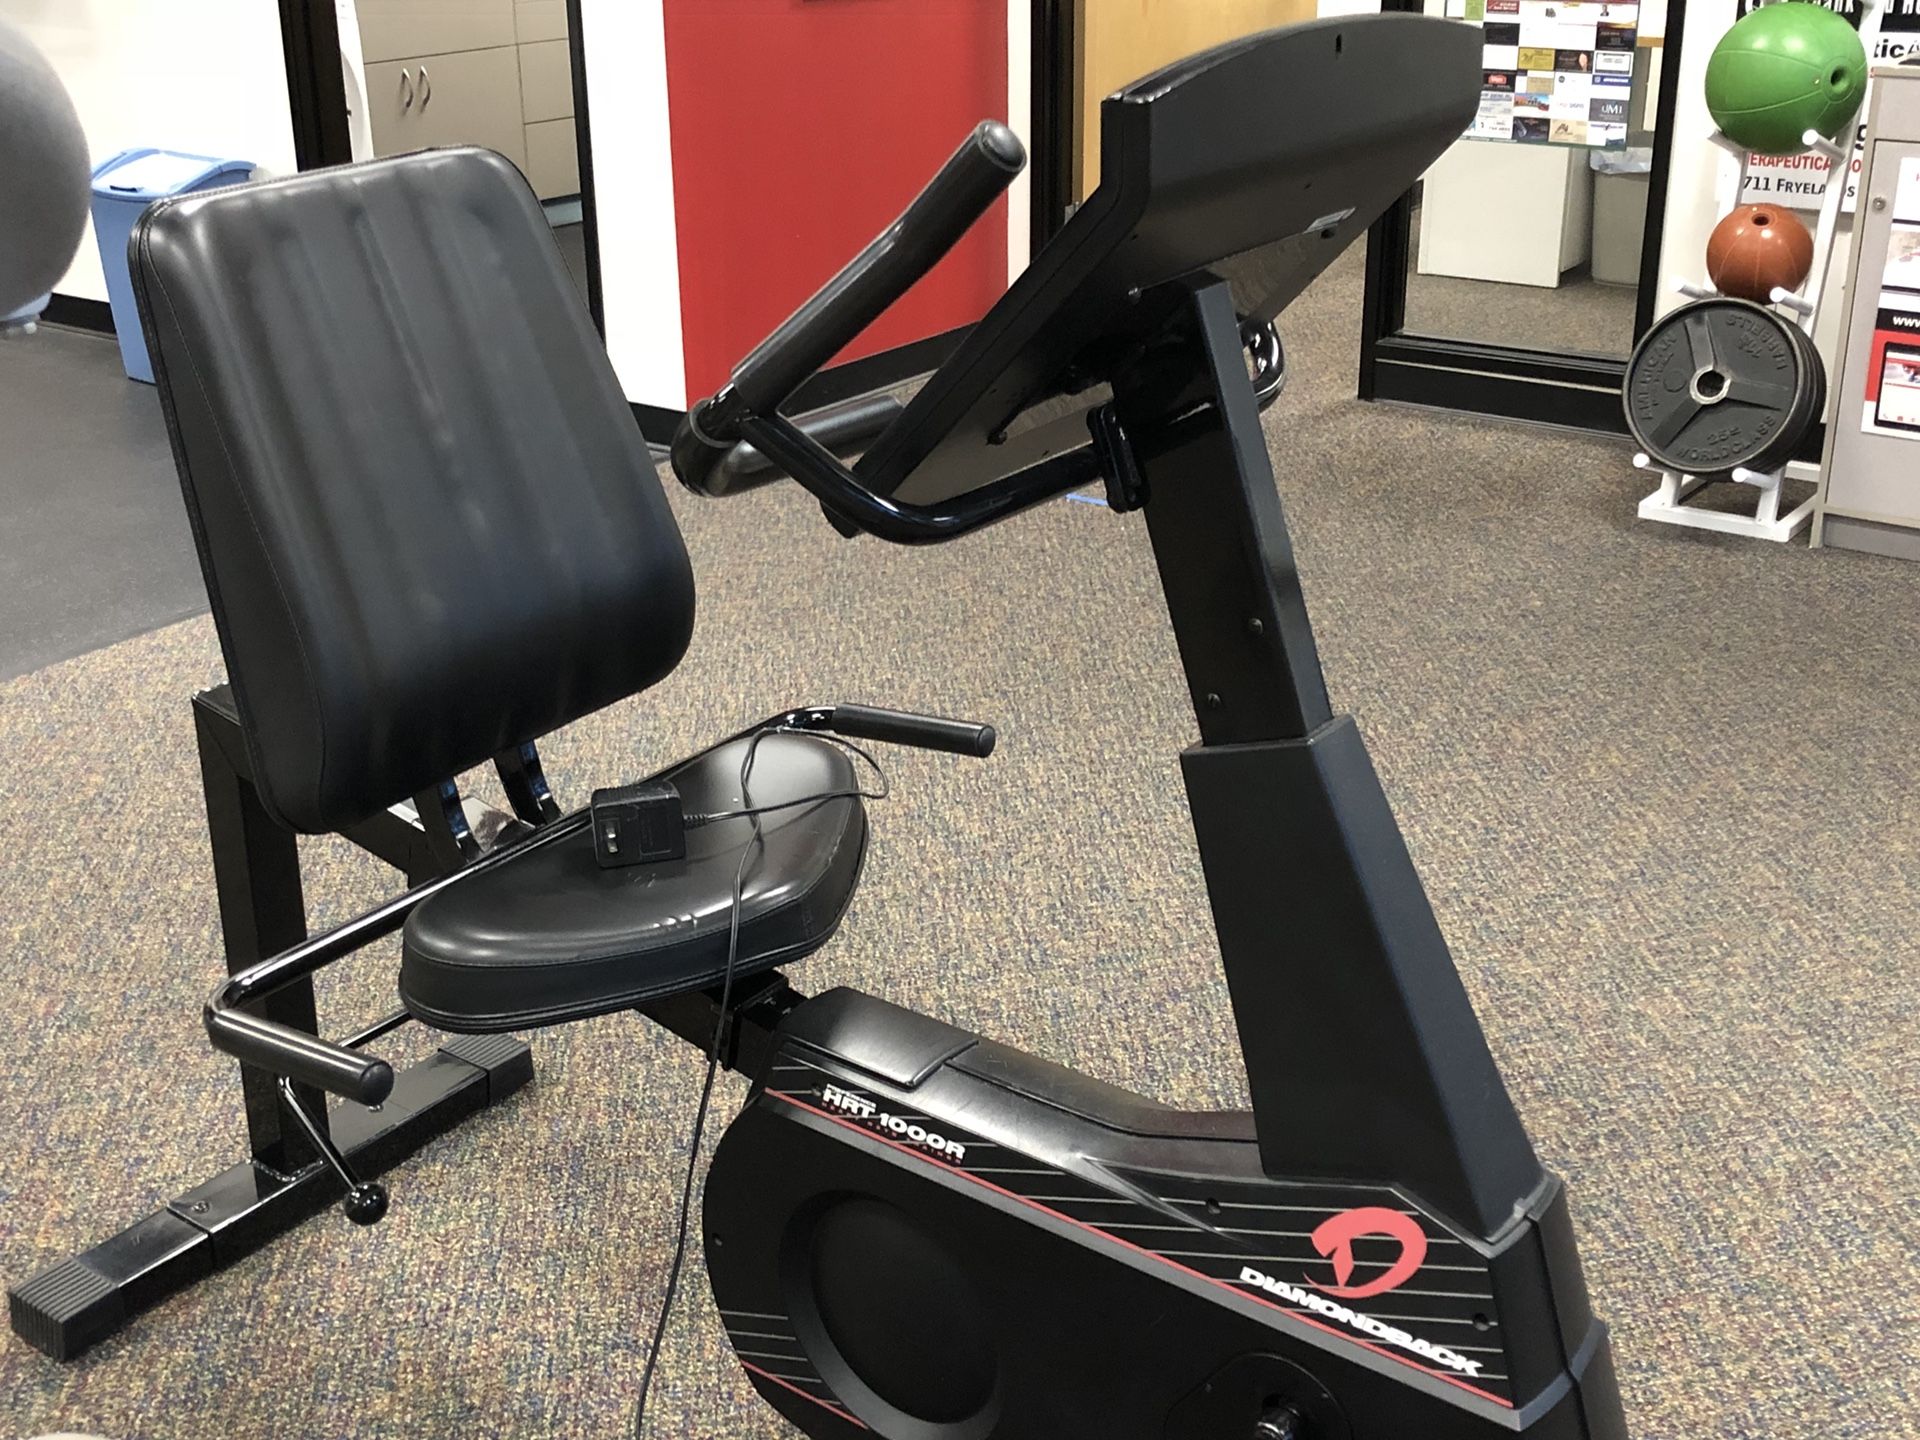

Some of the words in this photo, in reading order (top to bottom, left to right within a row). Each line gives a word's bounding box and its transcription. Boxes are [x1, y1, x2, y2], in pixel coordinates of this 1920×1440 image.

[822, 1086, 876, 1119] HRT
[880, 1112, 966, 1160] 1000R
[1239, 1266, 1484, 1378] DIAMONDBACK
